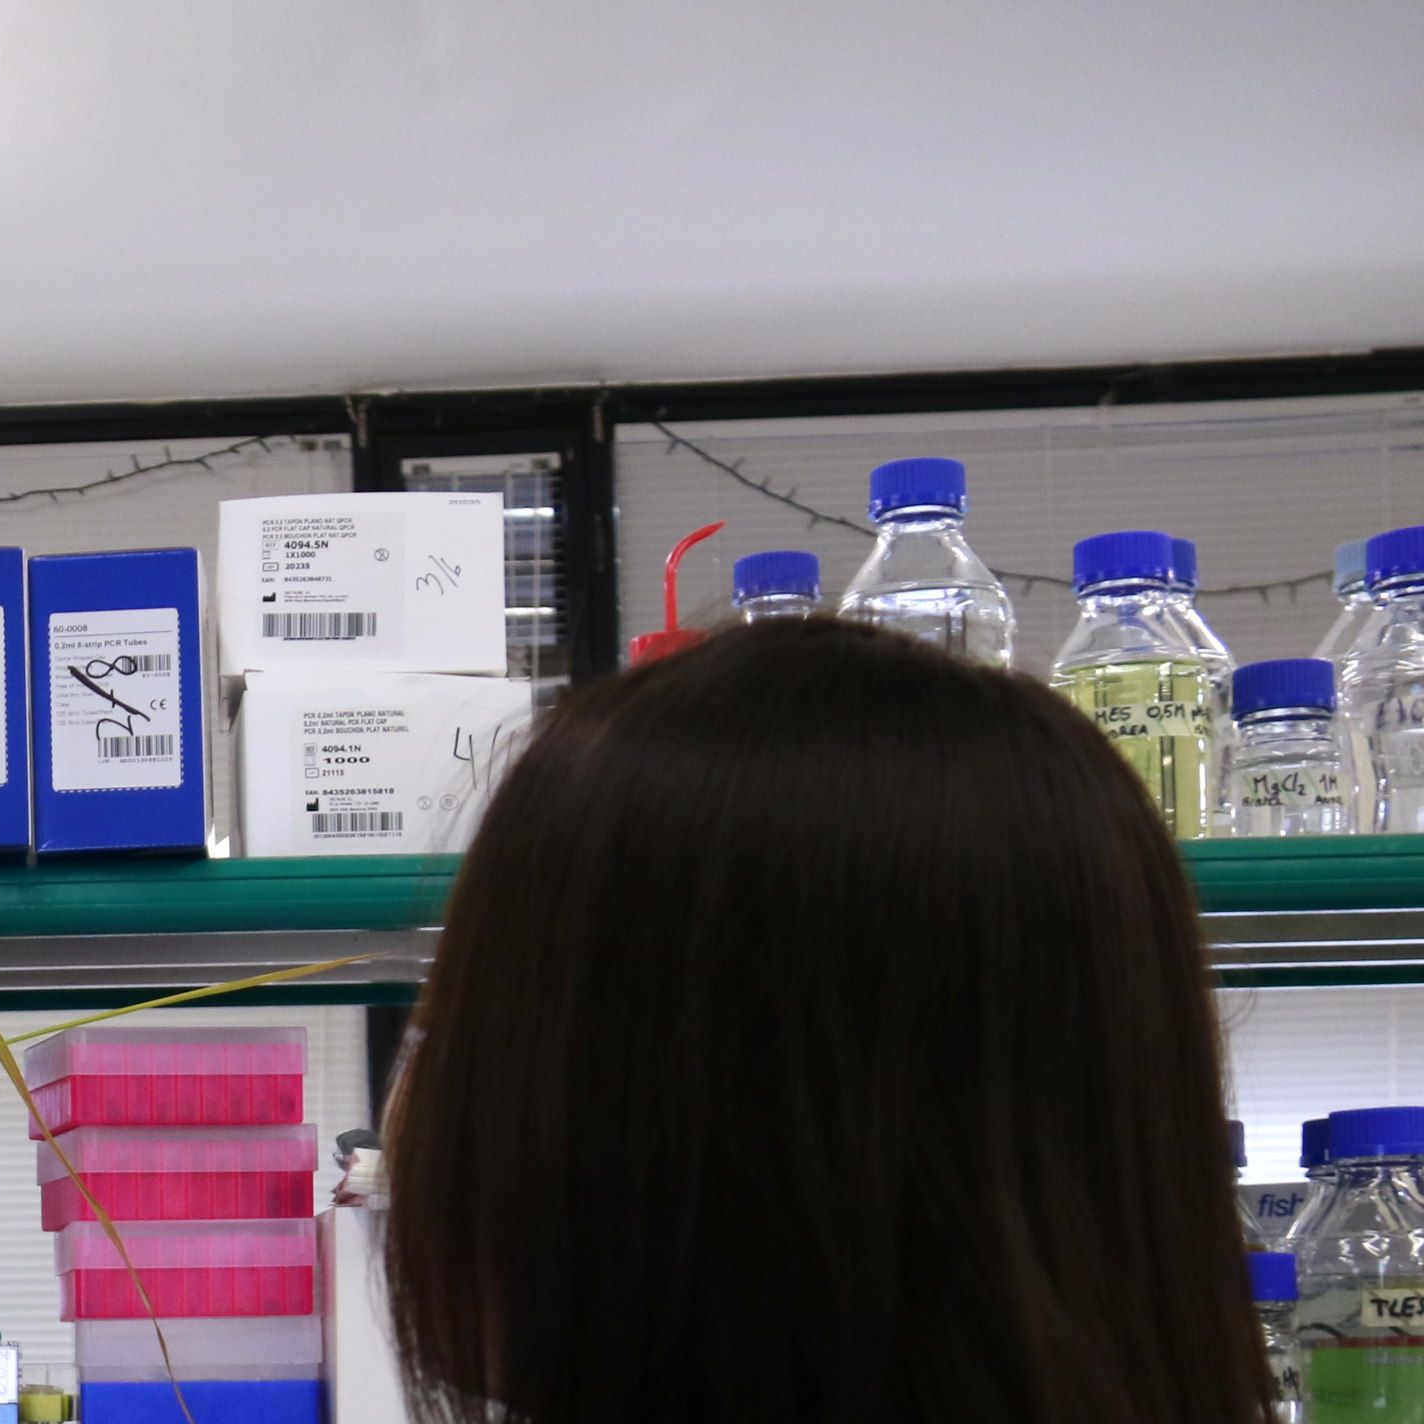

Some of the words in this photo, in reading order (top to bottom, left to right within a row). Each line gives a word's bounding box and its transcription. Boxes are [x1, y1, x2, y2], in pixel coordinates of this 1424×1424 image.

[284, 540, 330, 550] 4094.5N
[54, 624, 88, 633] 60-0008
[77, 641, 102, 649] 8-strip
[104, 639, 121, 647] PCR
[322, 745, 361, 753] 4094.1N
[323, 756, 370, 764] 1000
